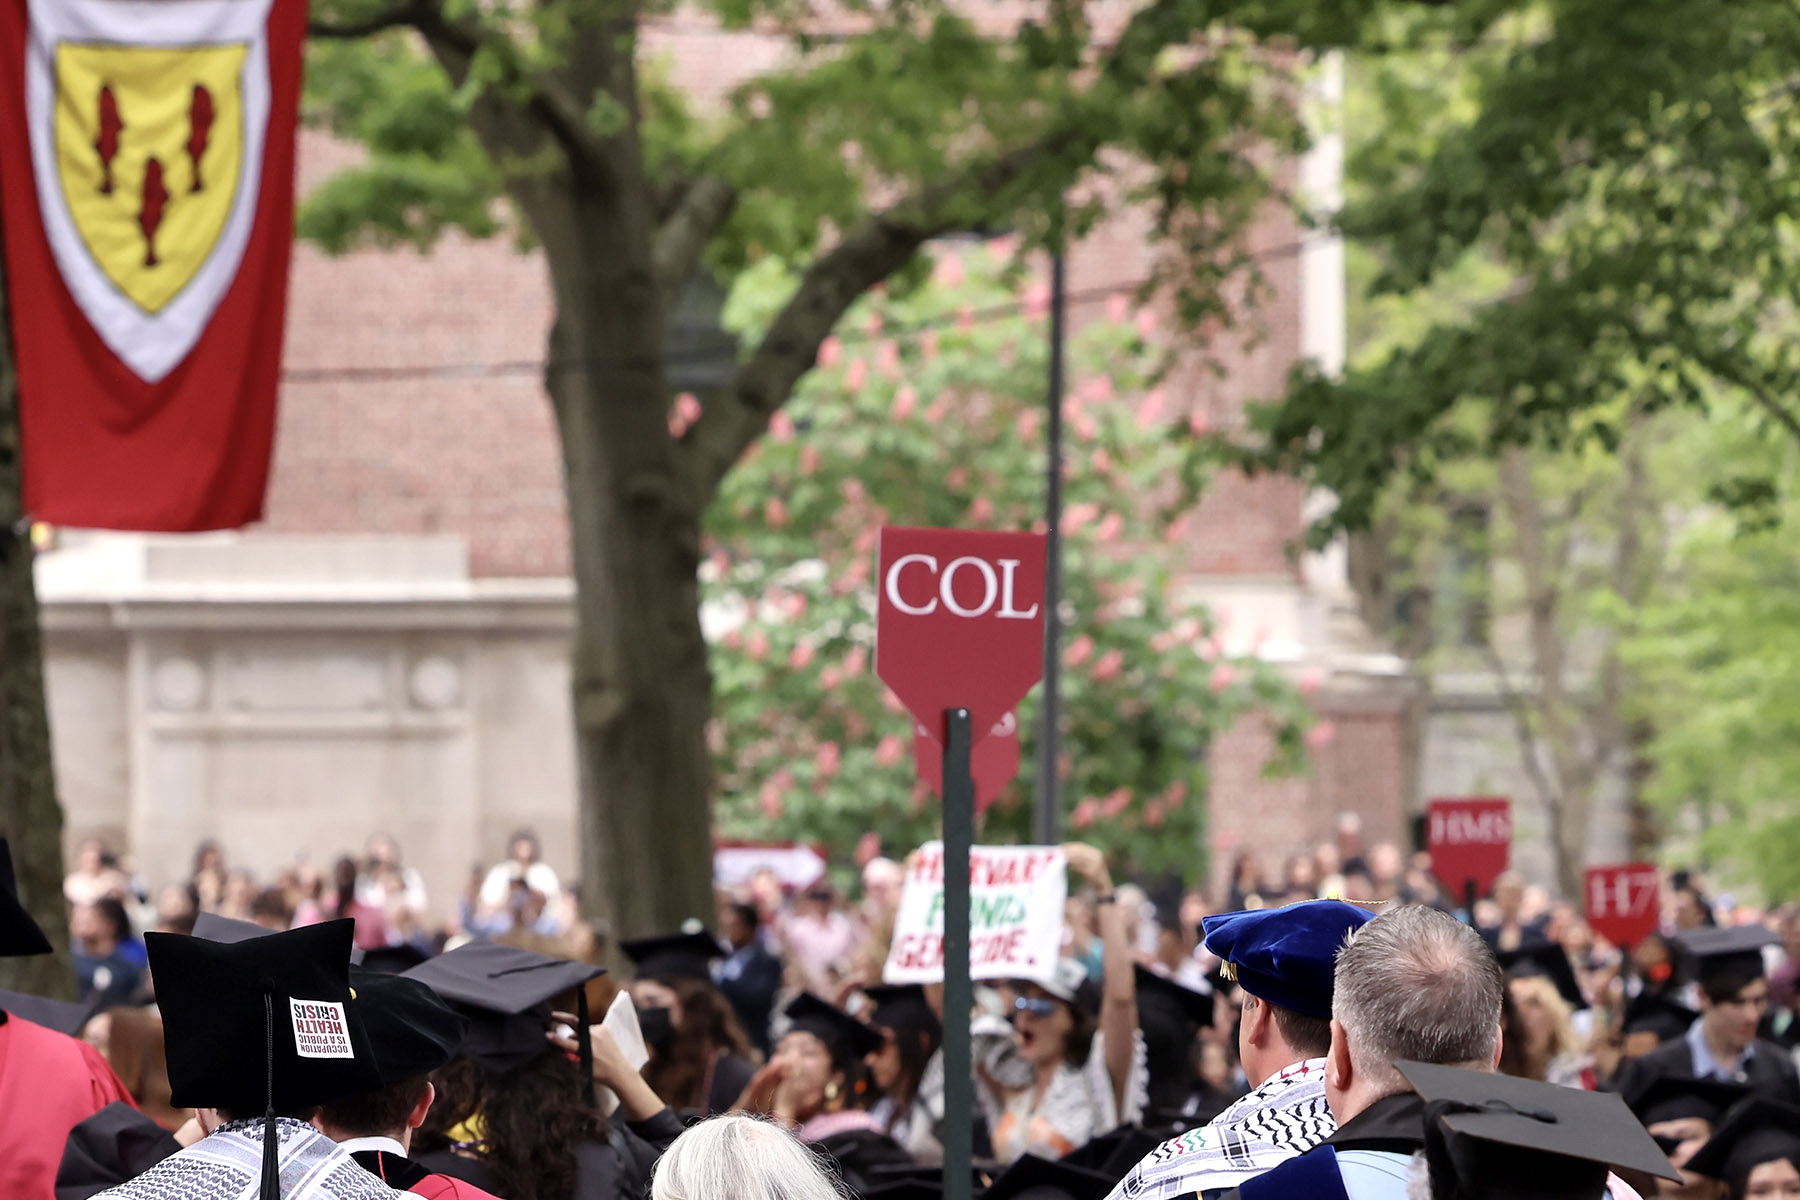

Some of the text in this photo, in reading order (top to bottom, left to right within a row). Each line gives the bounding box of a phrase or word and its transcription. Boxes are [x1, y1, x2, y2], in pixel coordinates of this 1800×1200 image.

[884, 553, 1039, 620] COL
[1430, 811, 1510, 845] HMS
[293, 1003, 340, 1020] CRISIS
[296, 1018, 343, 1034] HEALTH
[298, 1034, 346, 1045] IS A PUBLIC
[300, 1044, 348, 1054] OCCUPATION
